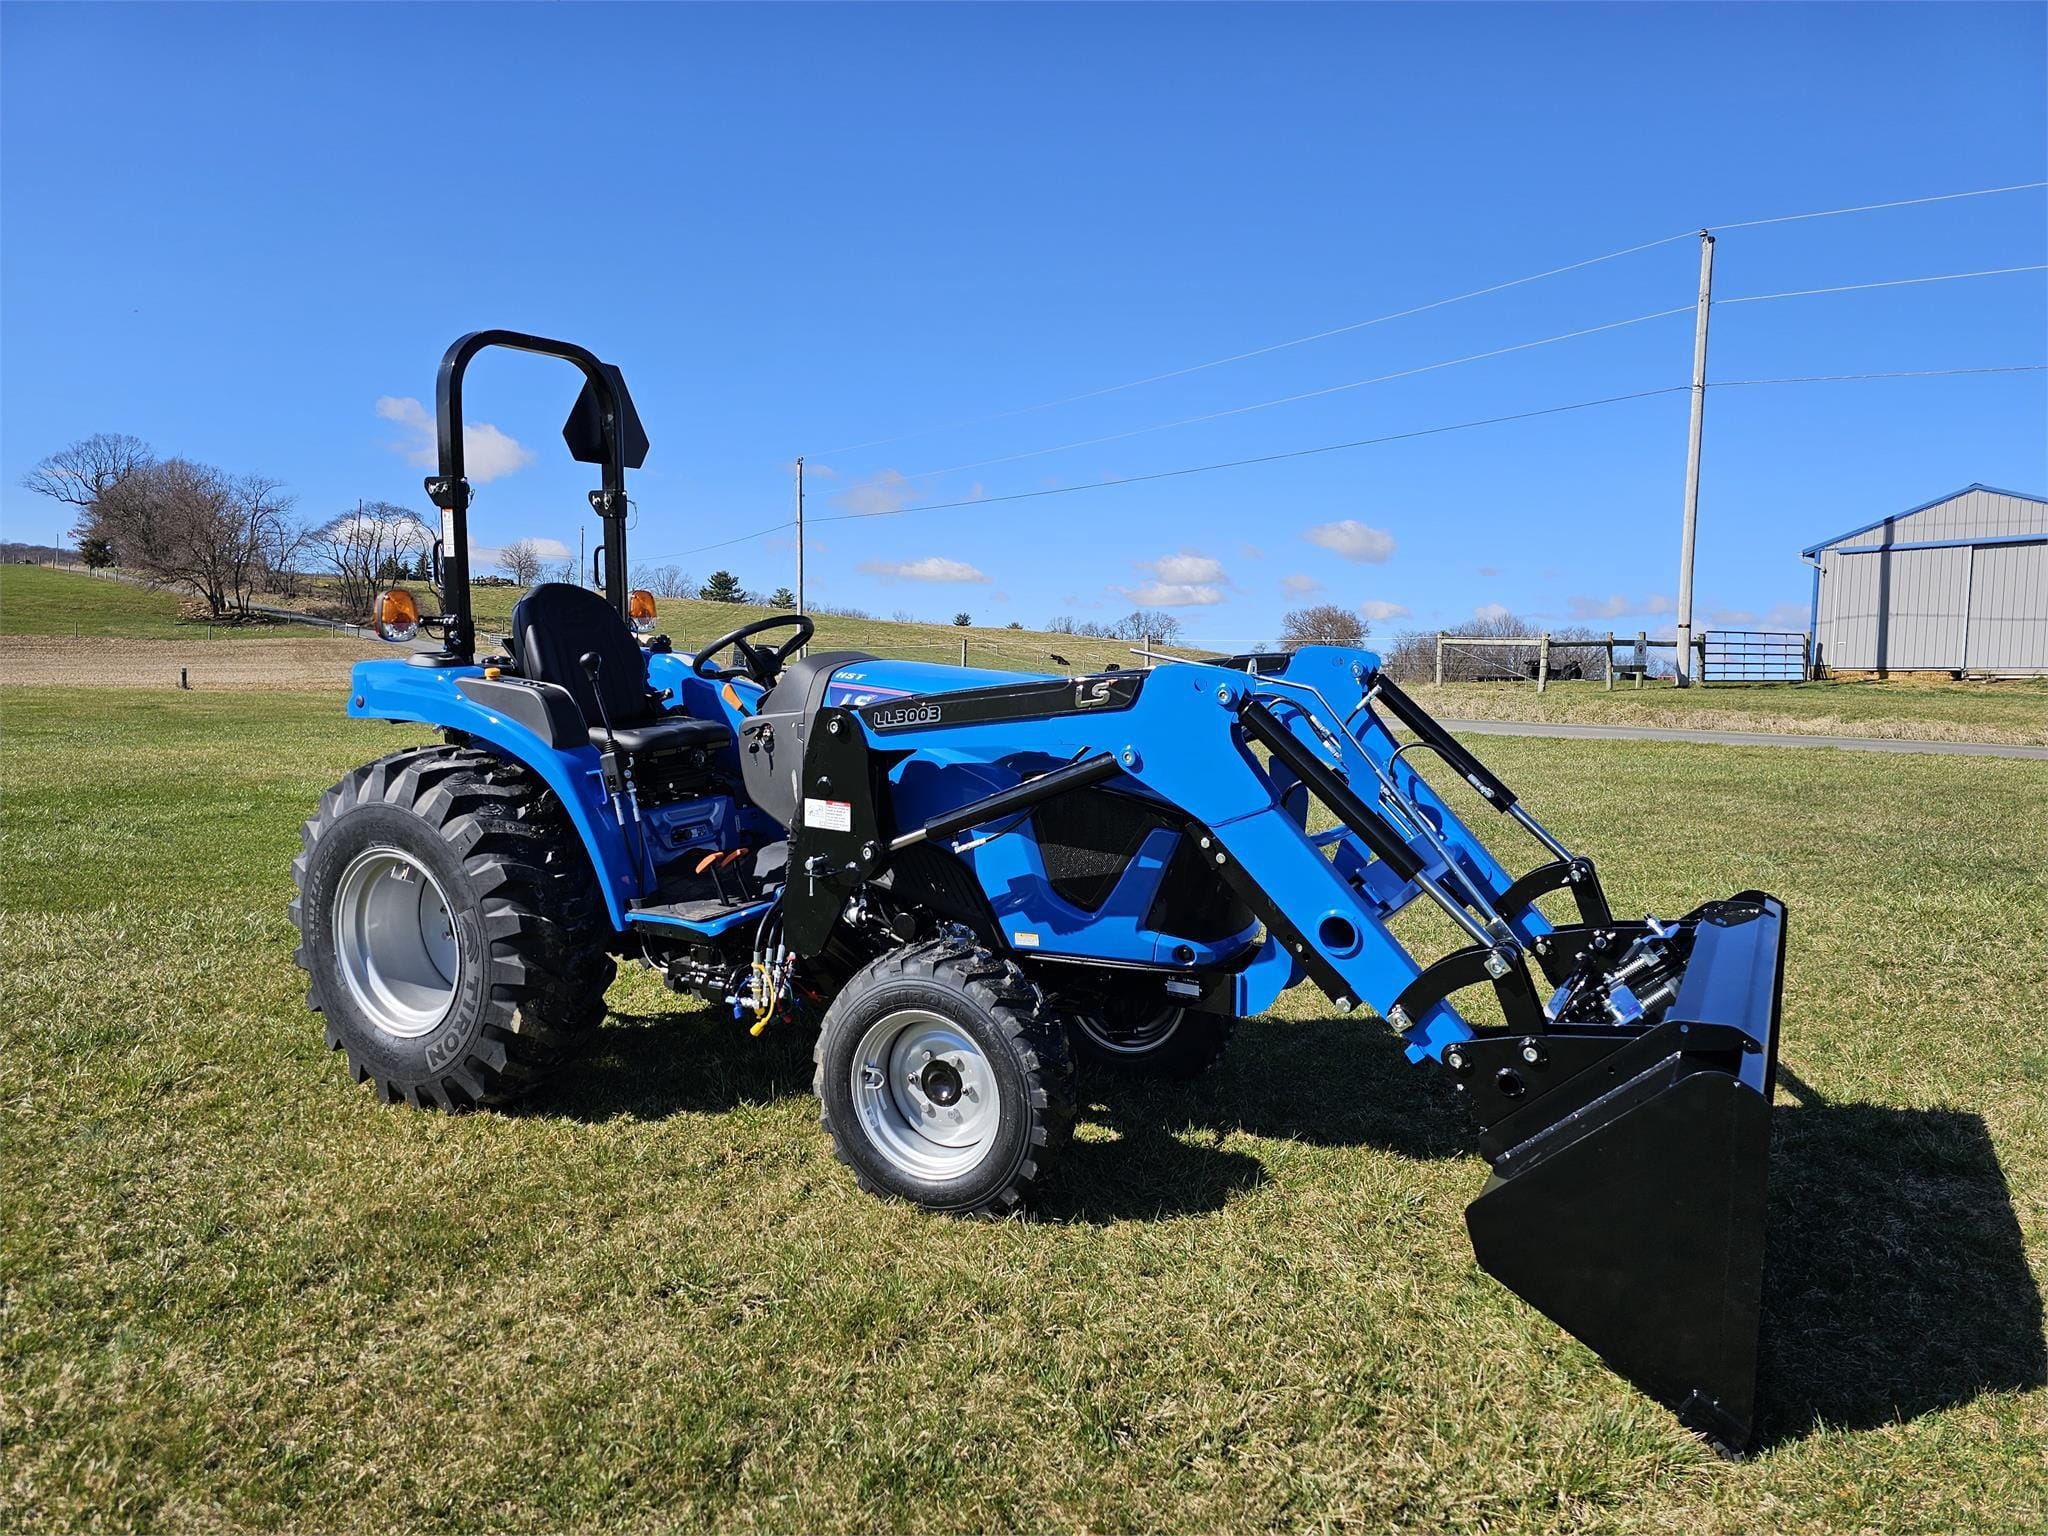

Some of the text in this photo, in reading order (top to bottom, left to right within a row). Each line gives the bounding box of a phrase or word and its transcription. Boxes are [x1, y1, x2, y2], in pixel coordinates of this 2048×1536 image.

[835, 671, 868, 681] HST
[1075, 682, 1111, 708] LS
[874, 706, 941, 728] LL3003
[428, 976, 480, 1067] TIRON
